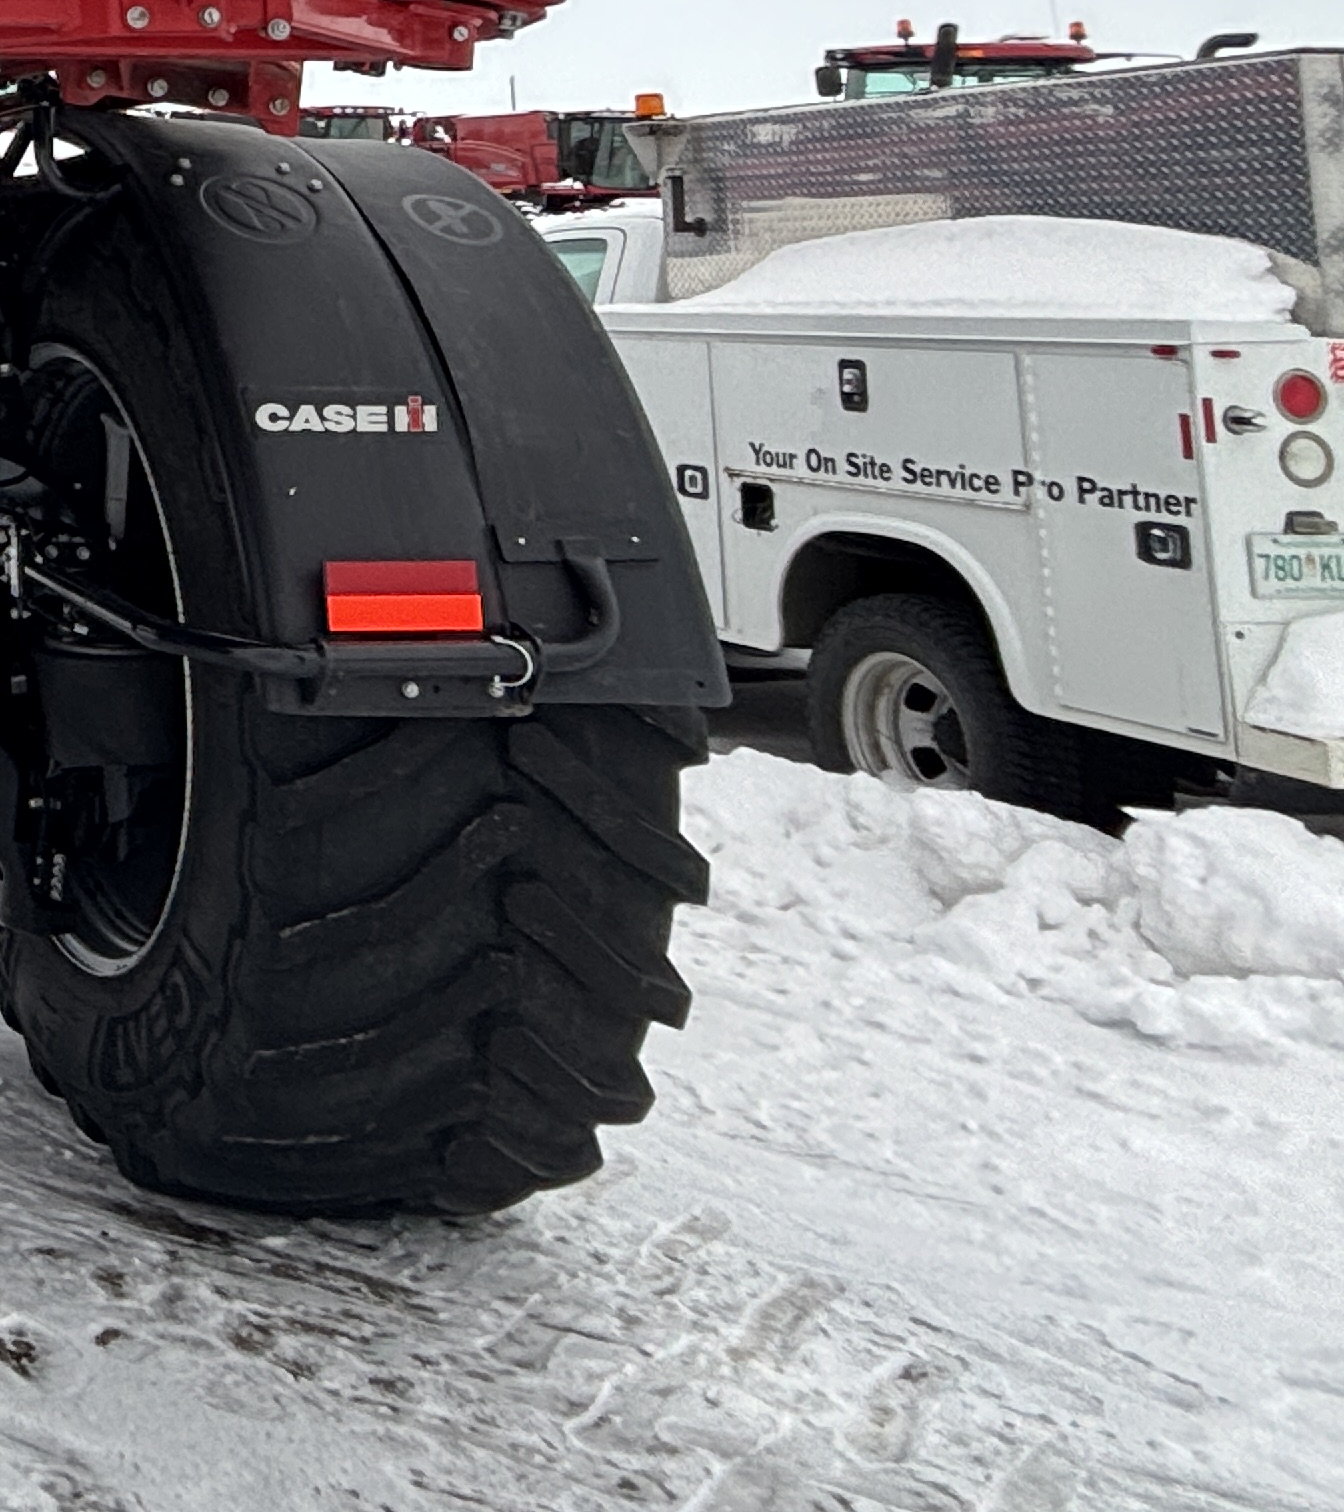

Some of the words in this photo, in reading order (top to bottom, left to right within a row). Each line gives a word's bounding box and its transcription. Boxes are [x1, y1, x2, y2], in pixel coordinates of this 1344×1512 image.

[255, 402, 388, 433] CASE
[748, 442, 797, 470] Your
[805, 448, 837, 476] On
[846, 452, 893, 482] Site
[901, 458, 1001, 495] Service
[1010, 468, 1065, 502] Po
[1076, 476, 1199, 519] Partner
[1257, 553, 1304, 582] 780
